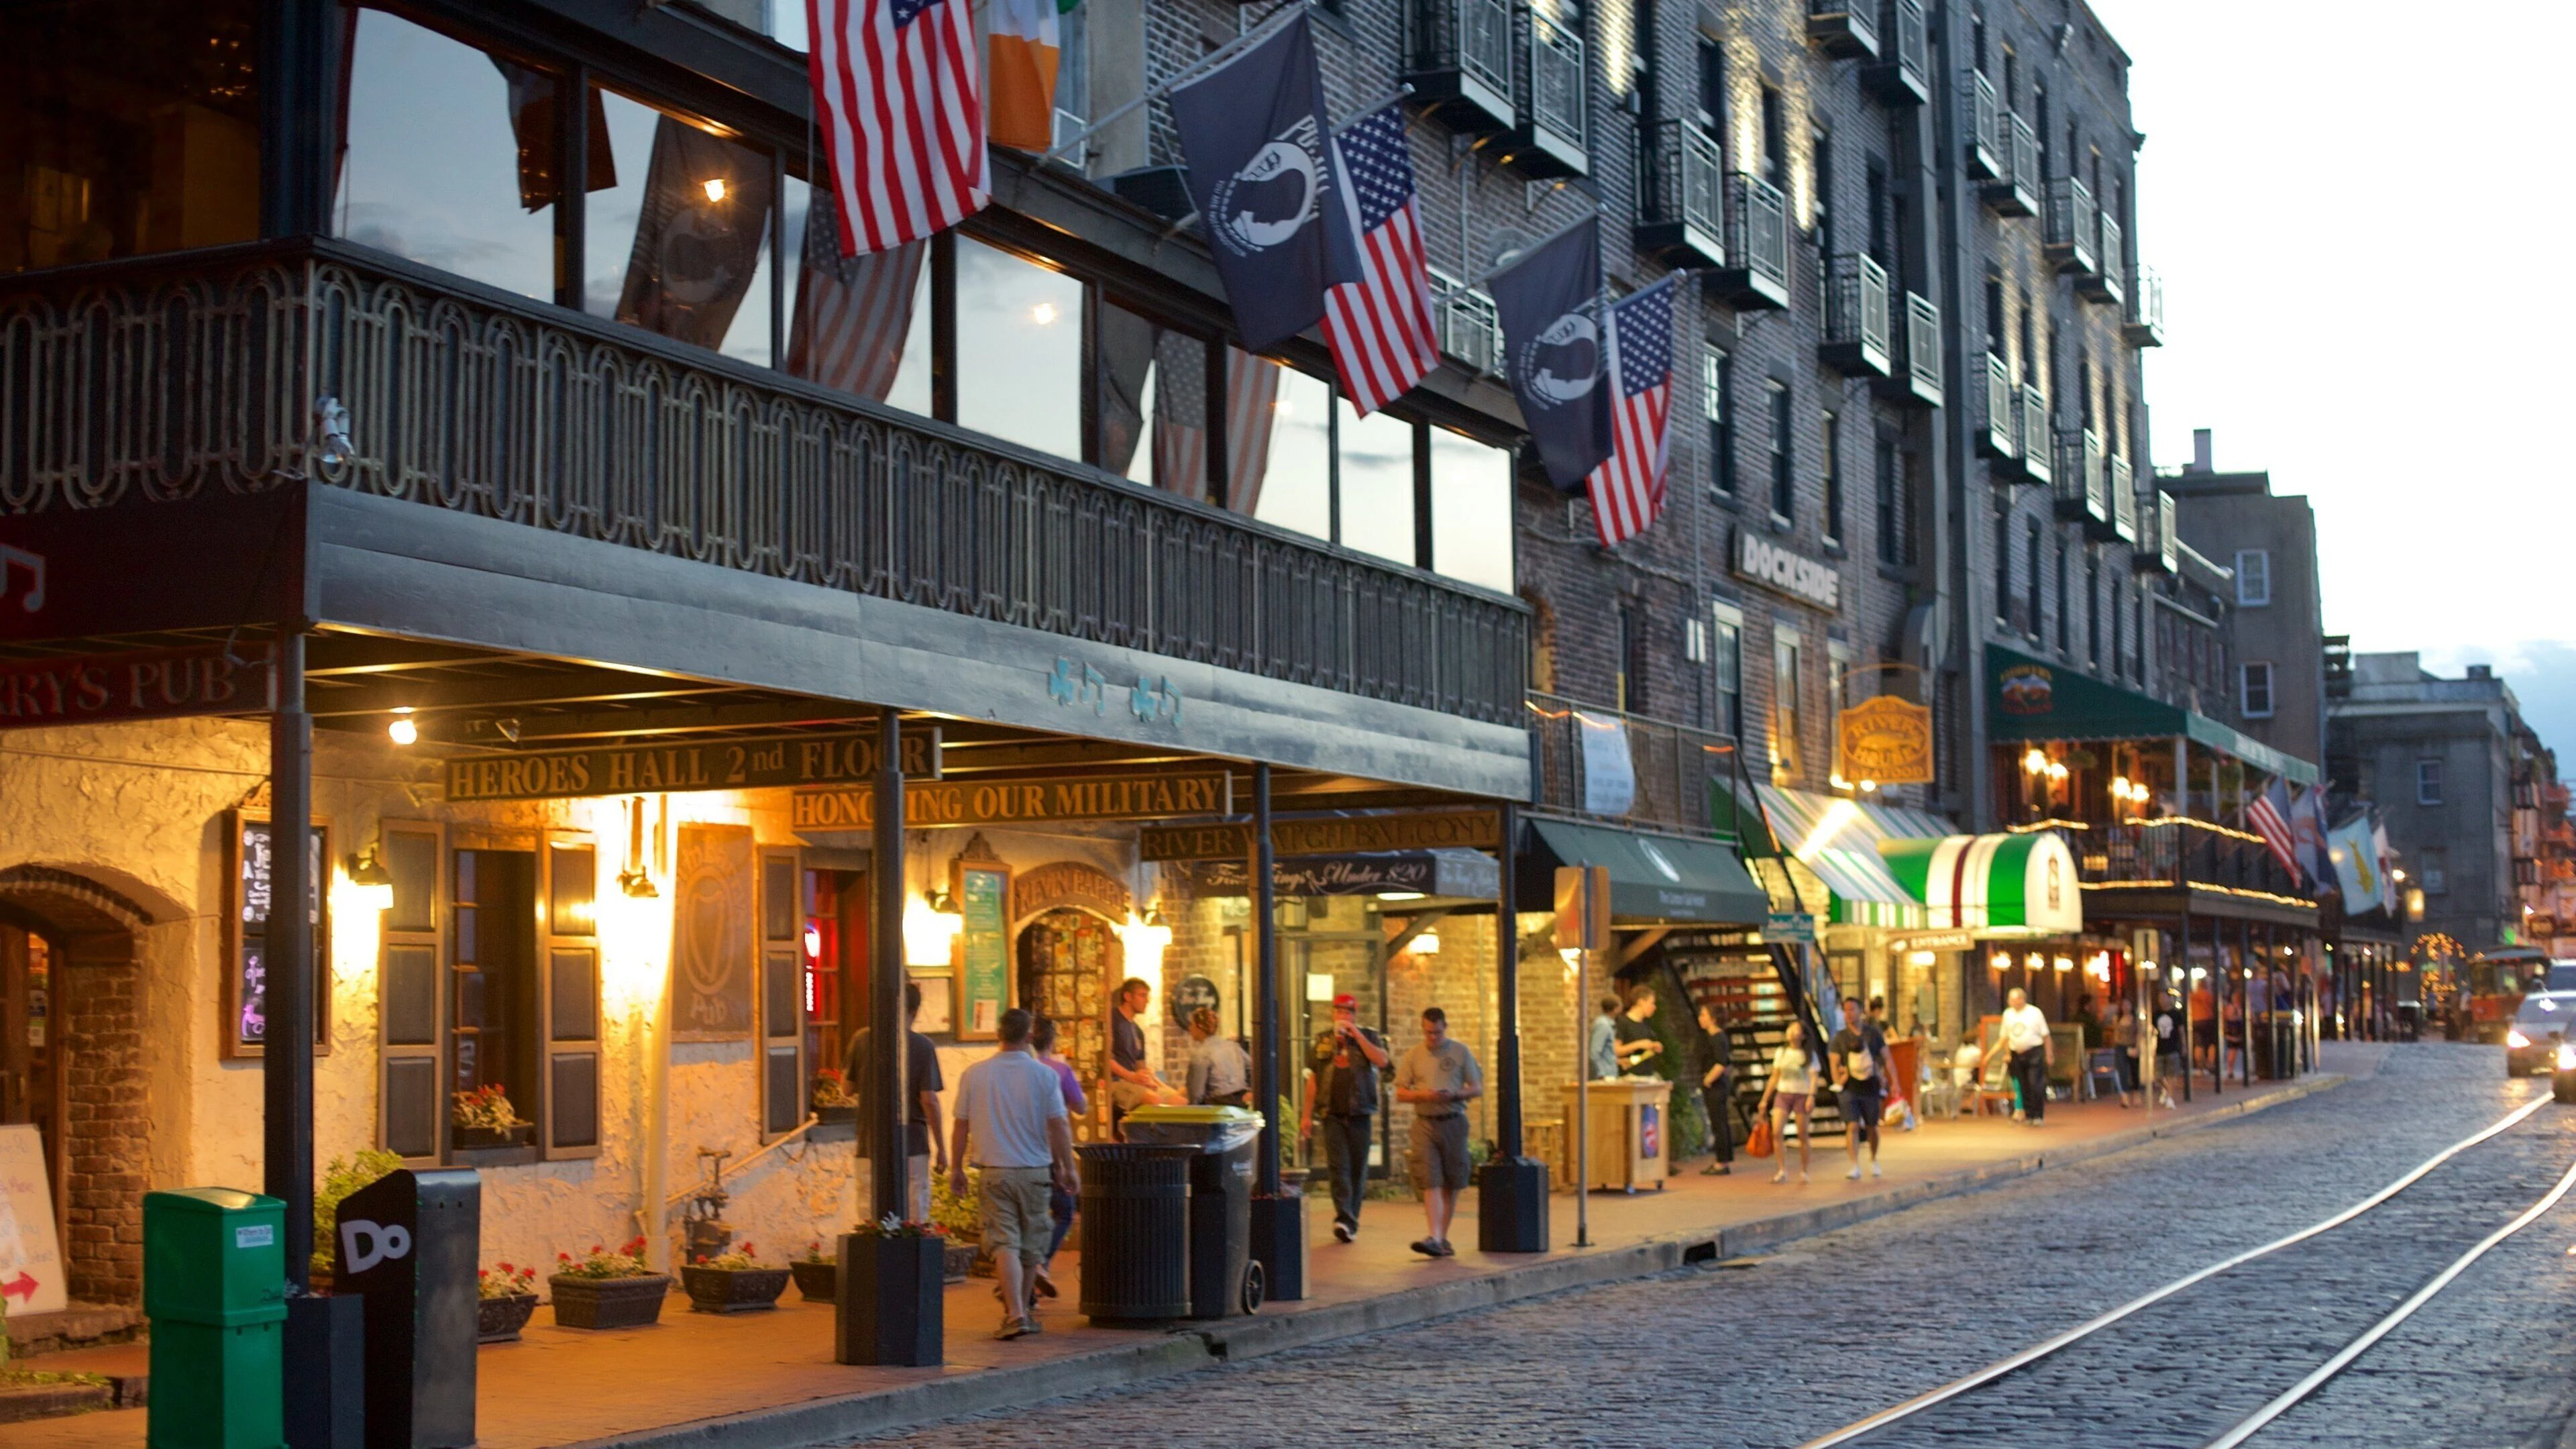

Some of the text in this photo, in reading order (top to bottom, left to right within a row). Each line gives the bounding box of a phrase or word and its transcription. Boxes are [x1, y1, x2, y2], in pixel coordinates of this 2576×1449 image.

[1743, 533, 1838, 607] DOCKSIDE
[0, 657, 235, 716] RY'S PUB
[1851, 714, 1917, 739] RIVER
[450, 753, 590, 798] HEROES
[608, 748, 709, 789] HALL
[726, 741, 785, 783] 2nd
[794, 778, 1221, 825] HONOING OUR MILITARY
[1142, 828, 1234, 857] RIVER
[1350, 814, 1495, 847] BALCONY
[1324, 861, 1383, 885] Under
[1385, 862, 1428, 882] $20
[1911, 933, 1968, 950] ENTRANCE
[339, 1220, 411, 1274] Do
